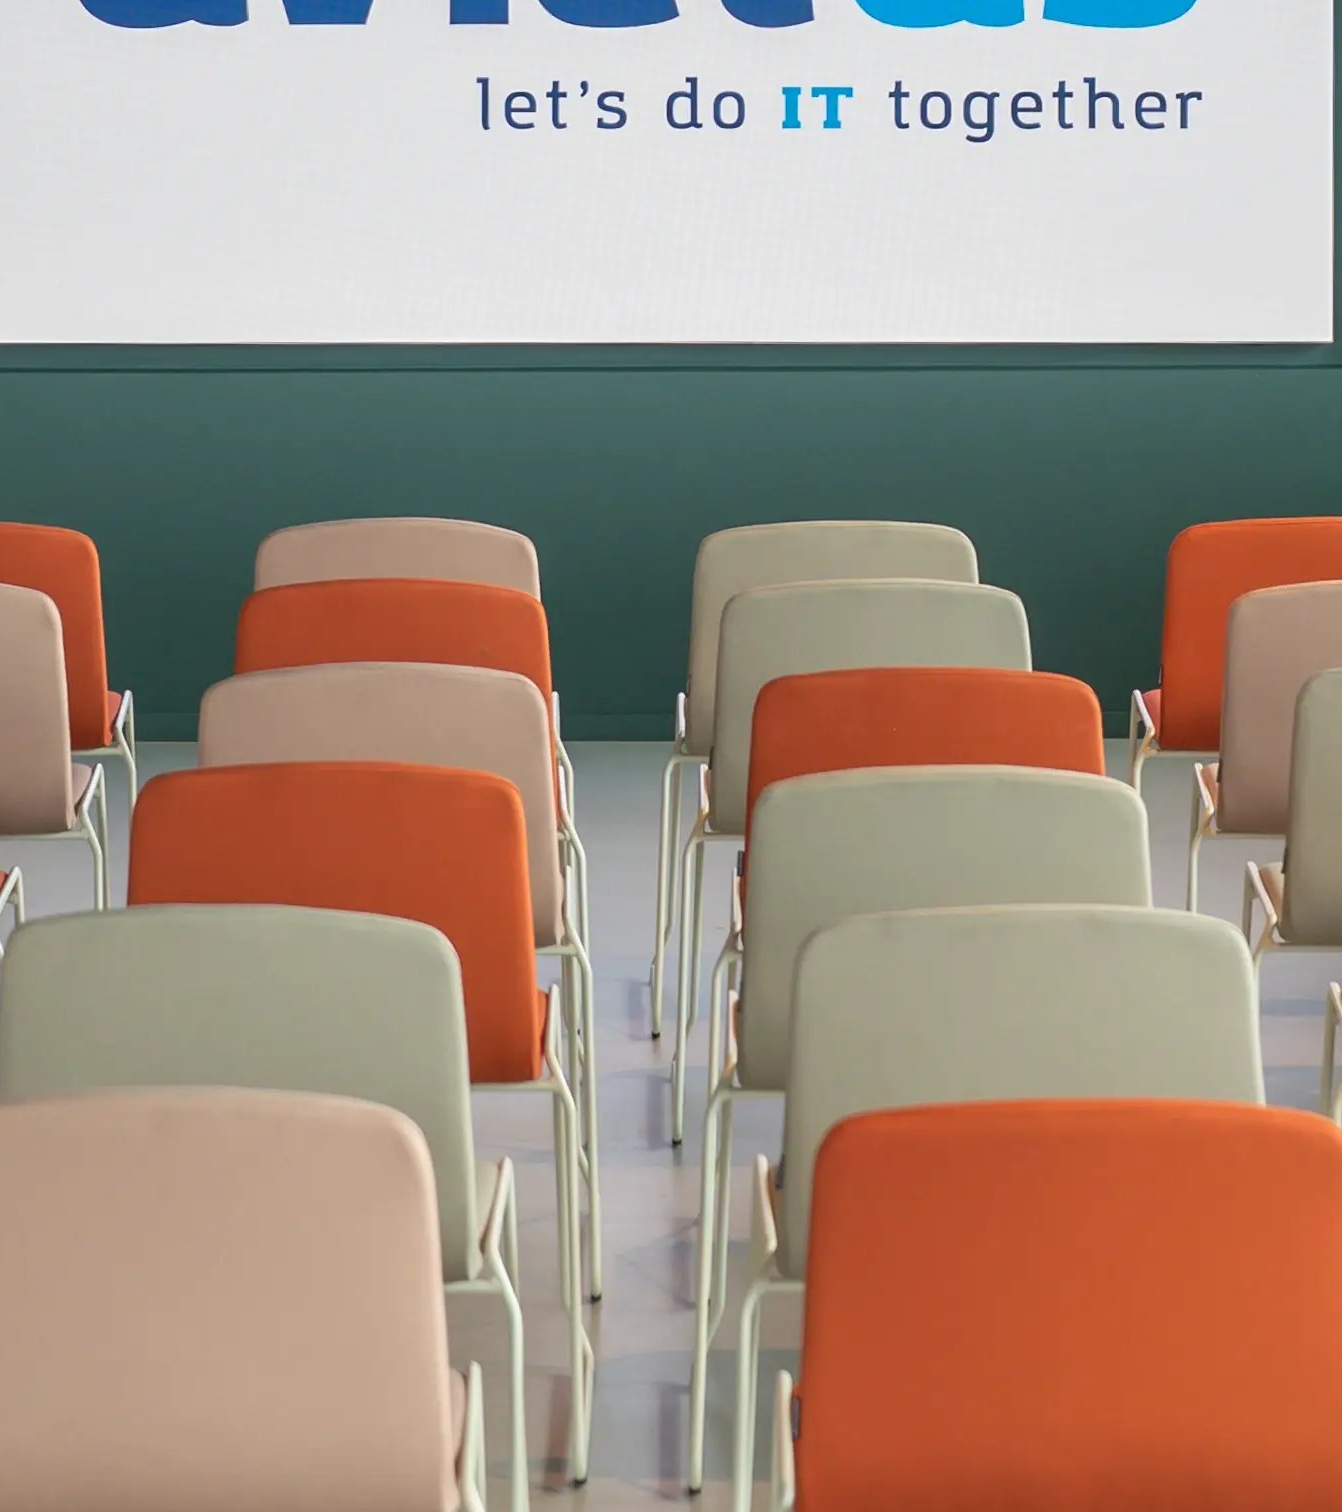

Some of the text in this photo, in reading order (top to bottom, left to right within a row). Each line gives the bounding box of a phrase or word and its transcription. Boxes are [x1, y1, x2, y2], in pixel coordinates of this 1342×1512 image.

[666, 76, 746, 130] do
[781, 86, 854, 130] IT
[888, 76, 1203, 143] together
